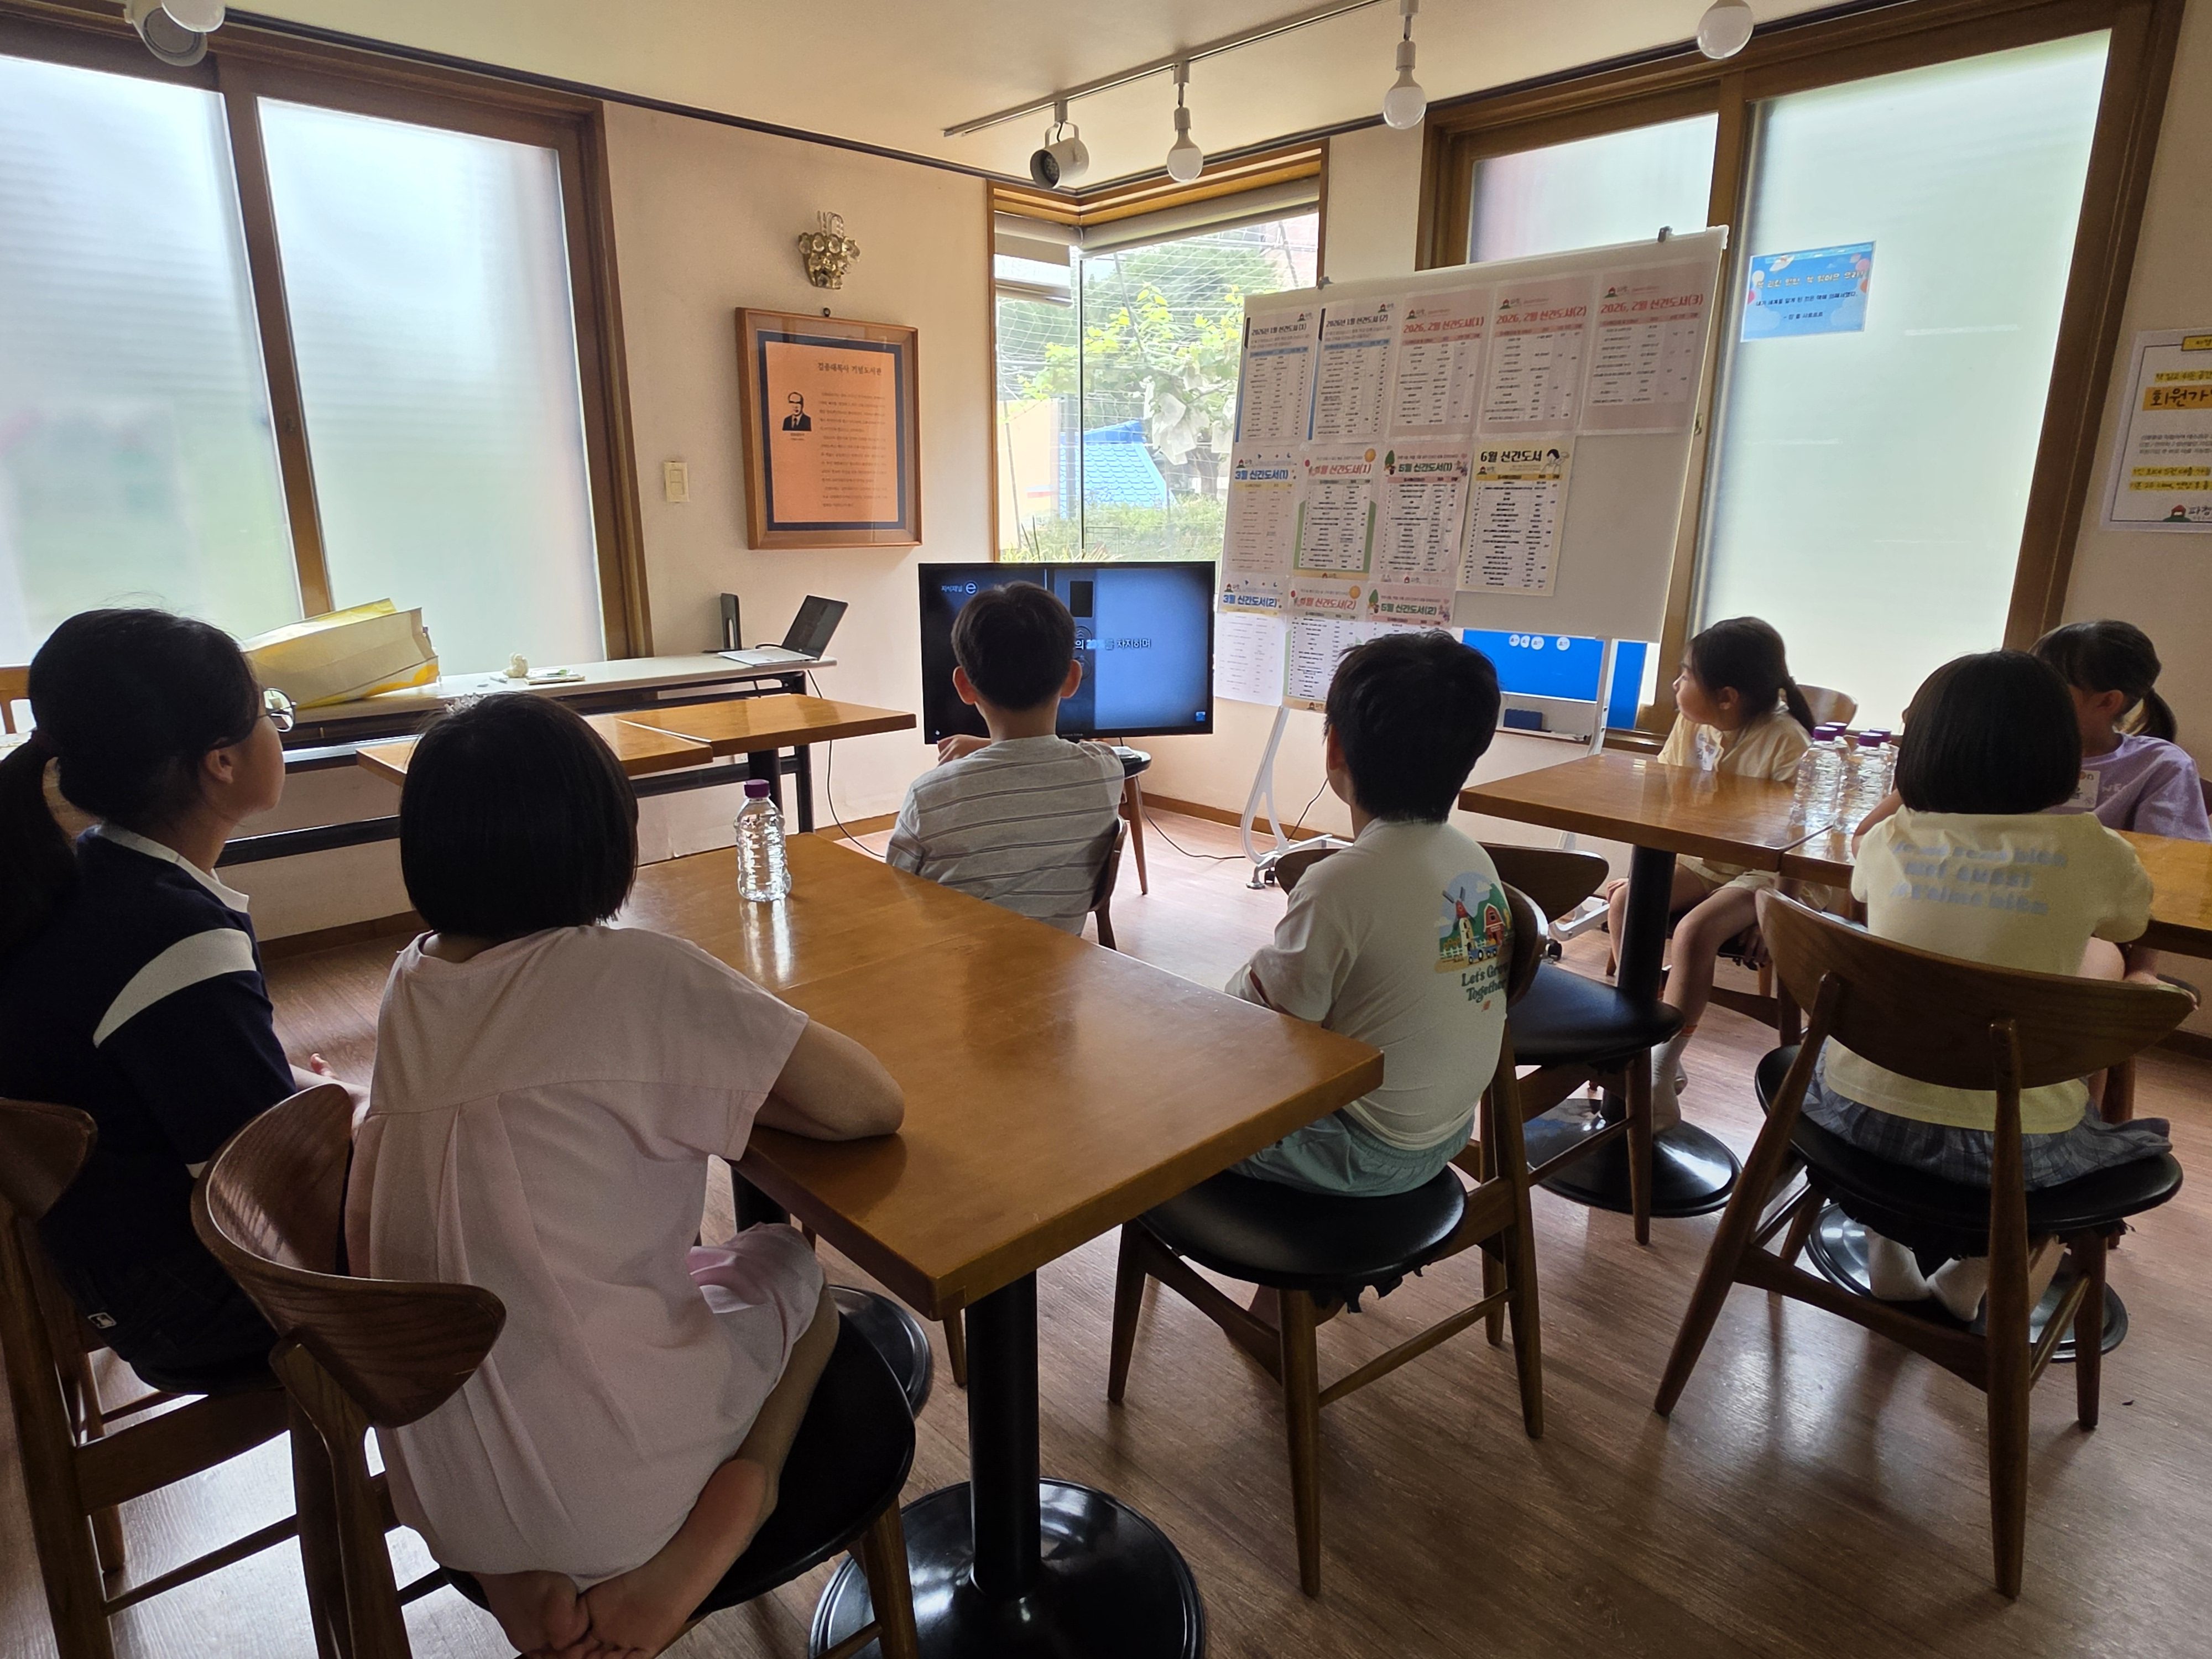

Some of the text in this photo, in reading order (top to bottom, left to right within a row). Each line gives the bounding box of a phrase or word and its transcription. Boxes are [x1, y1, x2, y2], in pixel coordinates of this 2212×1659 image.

[1601, 294, 1703, 314] 2026, 2월 신간도서(3)
[1357, 316, 1378, 324] 신간도서
[1379, 314, 1389, 322] (2)
[1496, 306, 1587, 324] 2026, 2월 신간도서(2)
[1403, 324, 1426, 333] 2026,
[1428, 321, 1441, 331] 2월
[1442, 316, 1484, 330] 신간도서(1)
[852, 366, 881, 375] 기념도서관
[2150, 388, 2212, 407] 회원가
[1480, 450, 1542, 463] 6월 신간도서
[1329, 463, 1372, 474] 신간도서(1)
[1398, 462, 1453, 472] 5월 신간도서(1)
[1235, 469, 1289, 480] 3월 신간도서(1)
[966, 583, 977, 594] e
[1223, 594, 1277, 608] 3월 신간도서(2)
[1315, 597, 1357, 610] 신간도서(2)
[1381, 603, 1437, 615] 5월 신간도서(2)
[1117, 639, 1151, 649] 차지하며
[1461, 968, 1485, 987] Let's
